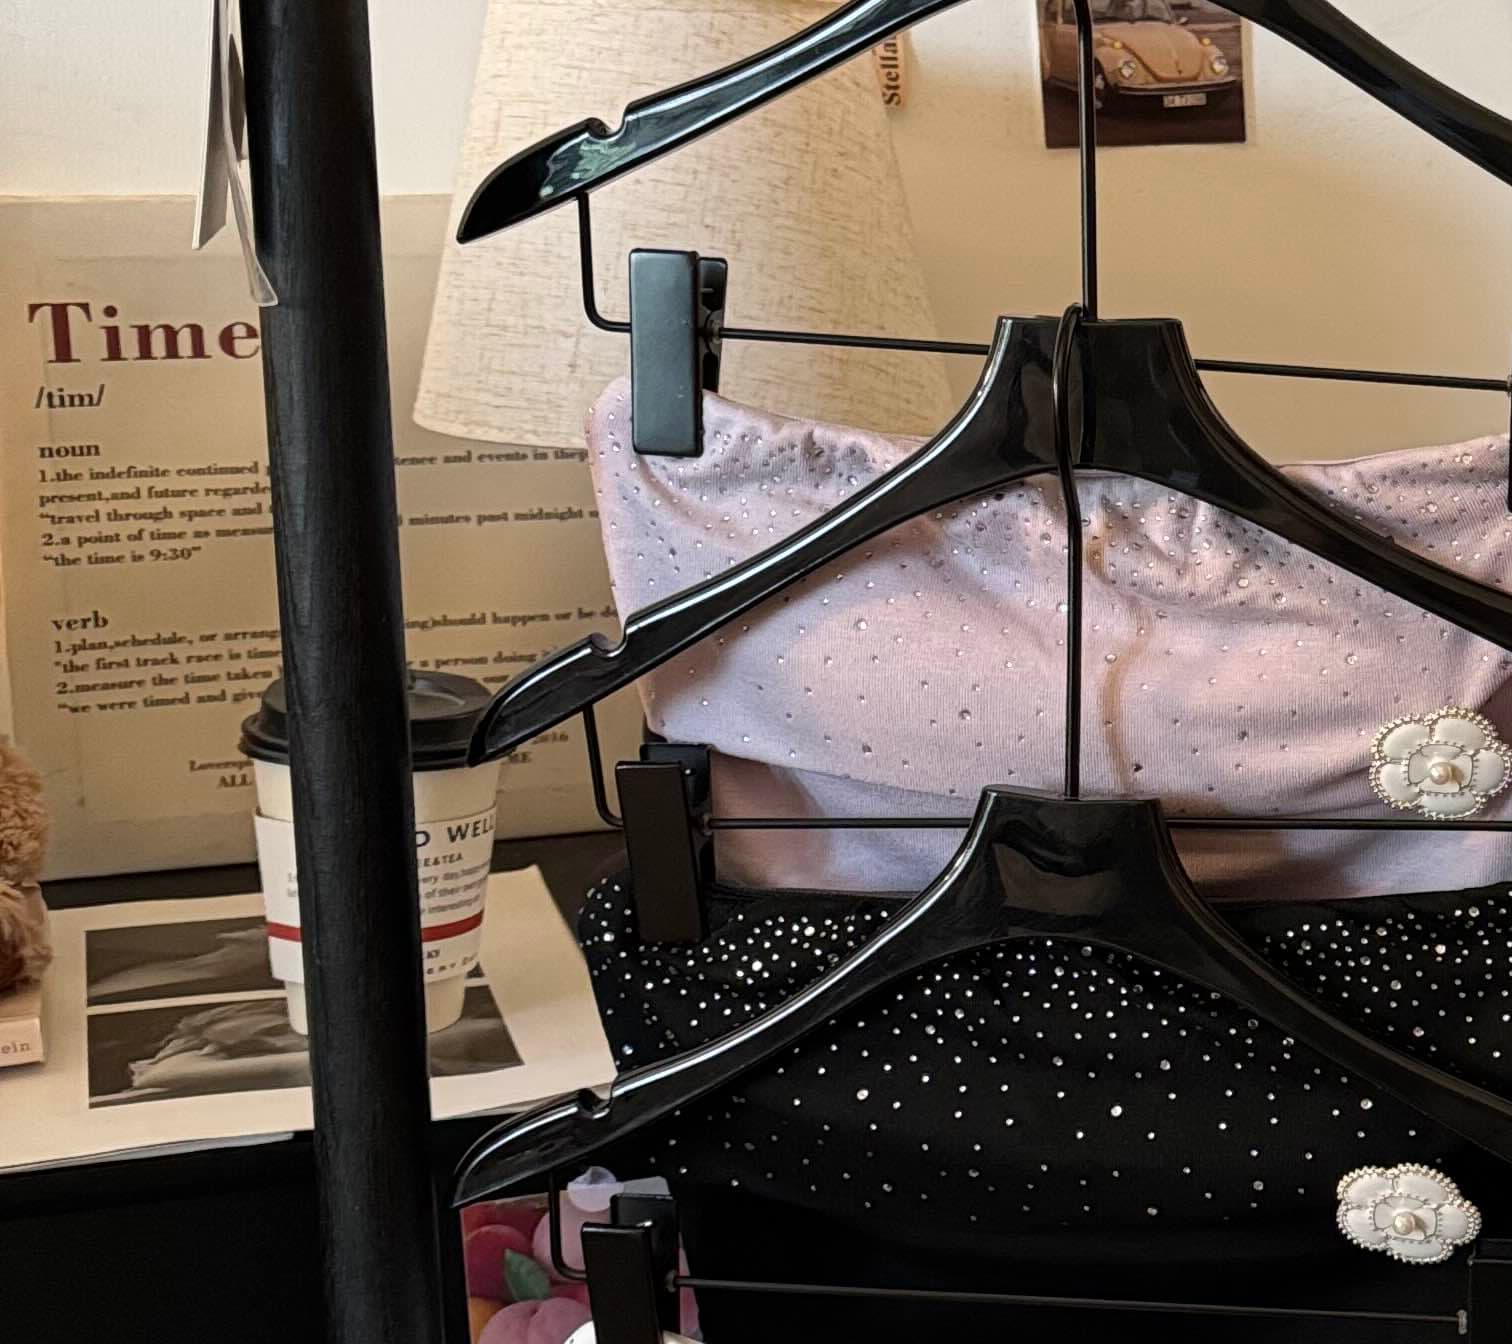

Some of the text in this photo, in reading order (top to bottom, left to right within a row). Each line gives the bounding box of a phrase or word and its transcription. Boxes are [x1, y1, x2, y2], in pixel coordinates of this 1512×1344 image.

[28, 302, 260, 364] Time
[35, 384, 105, 409] /tim/
[38, 444, 100, 458] noun
[89, 465, 171, 481] indefinite
[127, 528, 145, 542] of
[51, 610, 109, 631] verb
